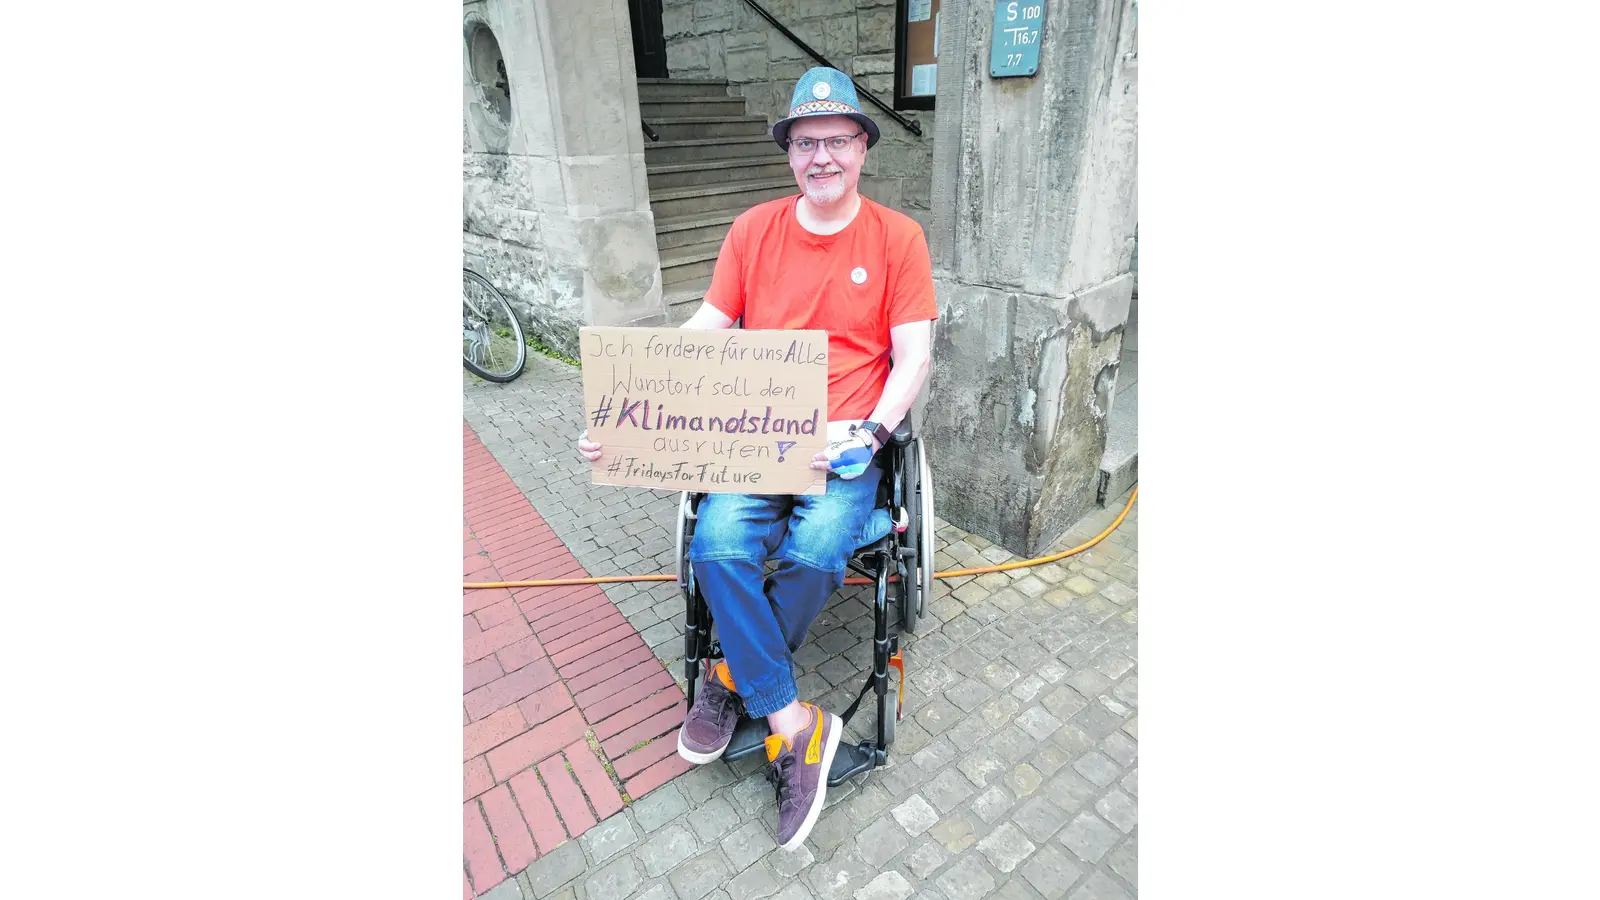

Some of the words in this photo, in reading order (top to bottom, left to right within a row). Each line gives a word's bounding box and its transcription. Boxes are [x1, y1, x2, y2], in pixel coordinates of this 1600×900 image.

[1007, 2, 1018, 21] S
[1022, 6, 1041, 20] 100
[644, 334, 716, 360] fordere
[720, 335, 748, 365] für
[612, 363, 706, 396] Wunstorf
[712, 376, 751, 397] soll
[759, 376, 796, 400] den
[590, 394, 820, 436] #Klimanotstand
